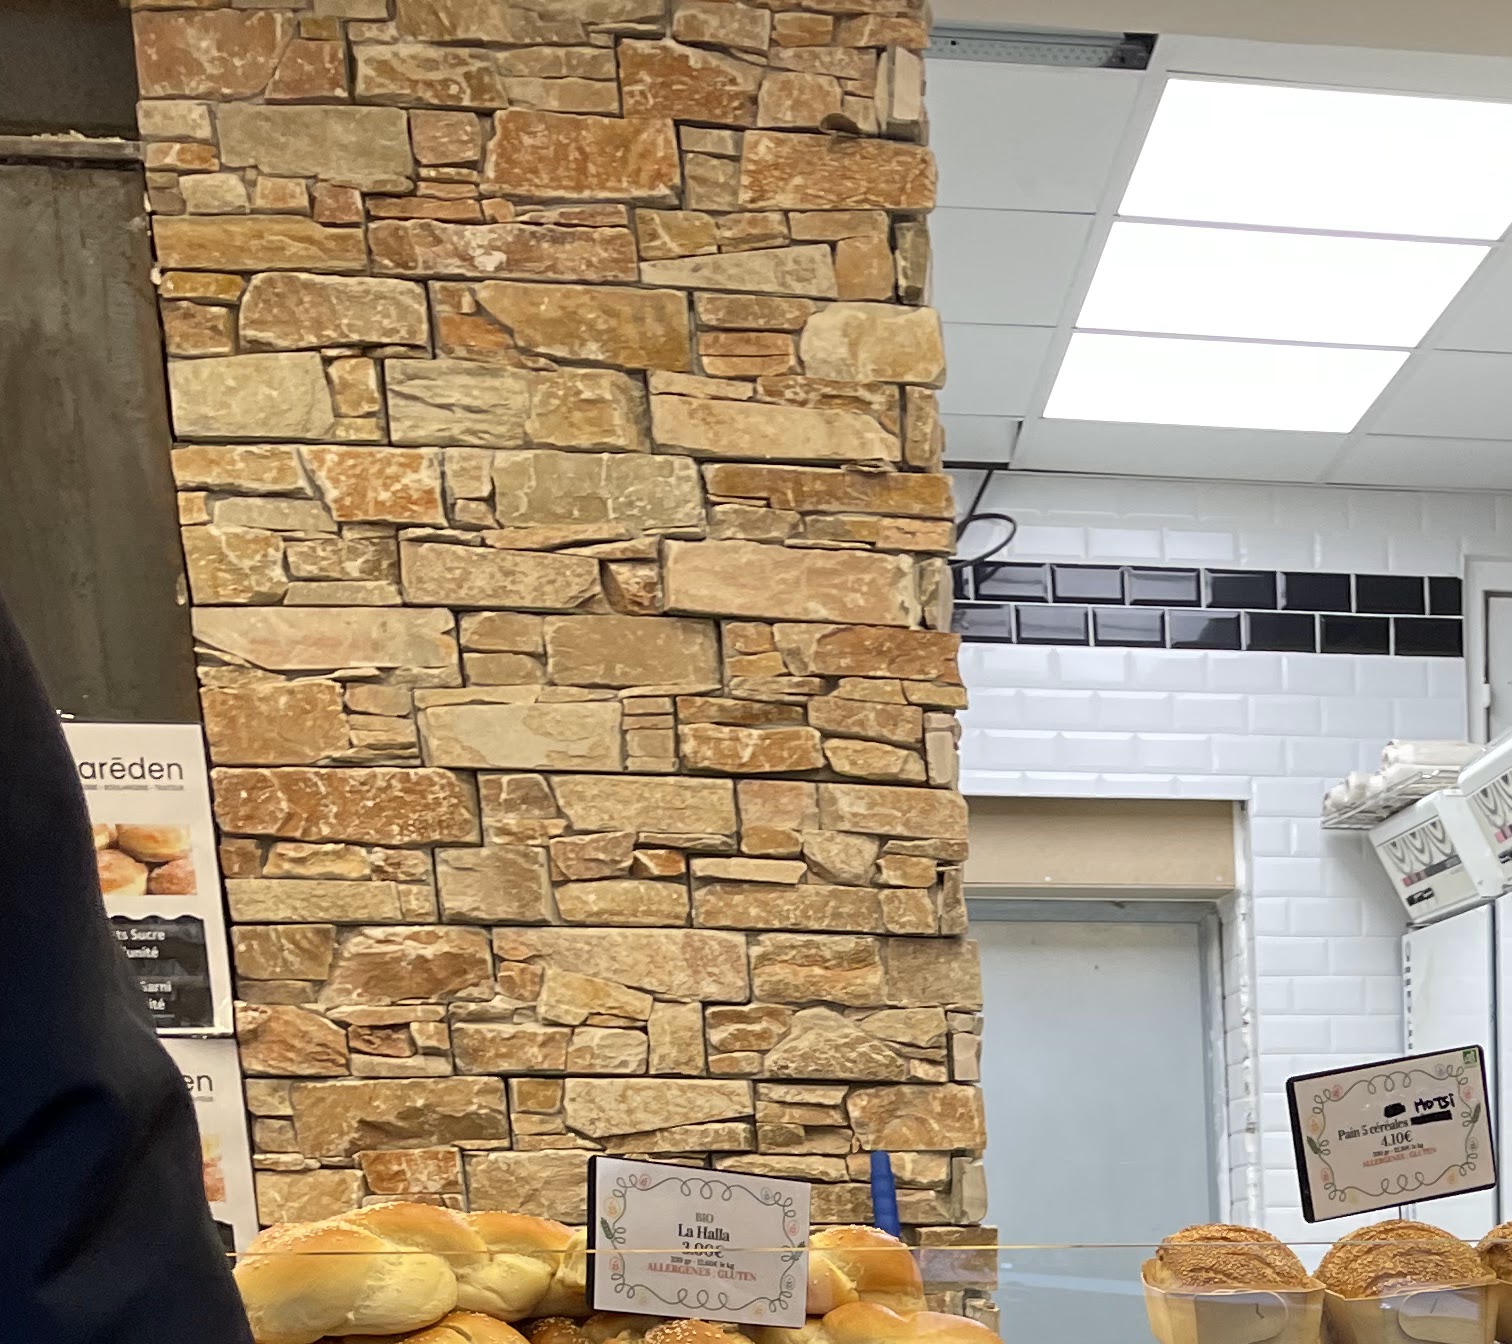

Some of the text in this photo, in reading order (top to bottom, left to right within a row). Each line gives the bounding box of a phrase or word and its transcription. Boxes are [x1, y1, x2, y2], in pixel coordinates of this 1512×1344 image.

[1338, 1118, 1409, 1140] Pain 5 céréales
[1381, 1130, 1413, 1147] 4.10€
[696, 1212, 714, 1223] BIO
[678, 1223, 730, 1242] La Halla
